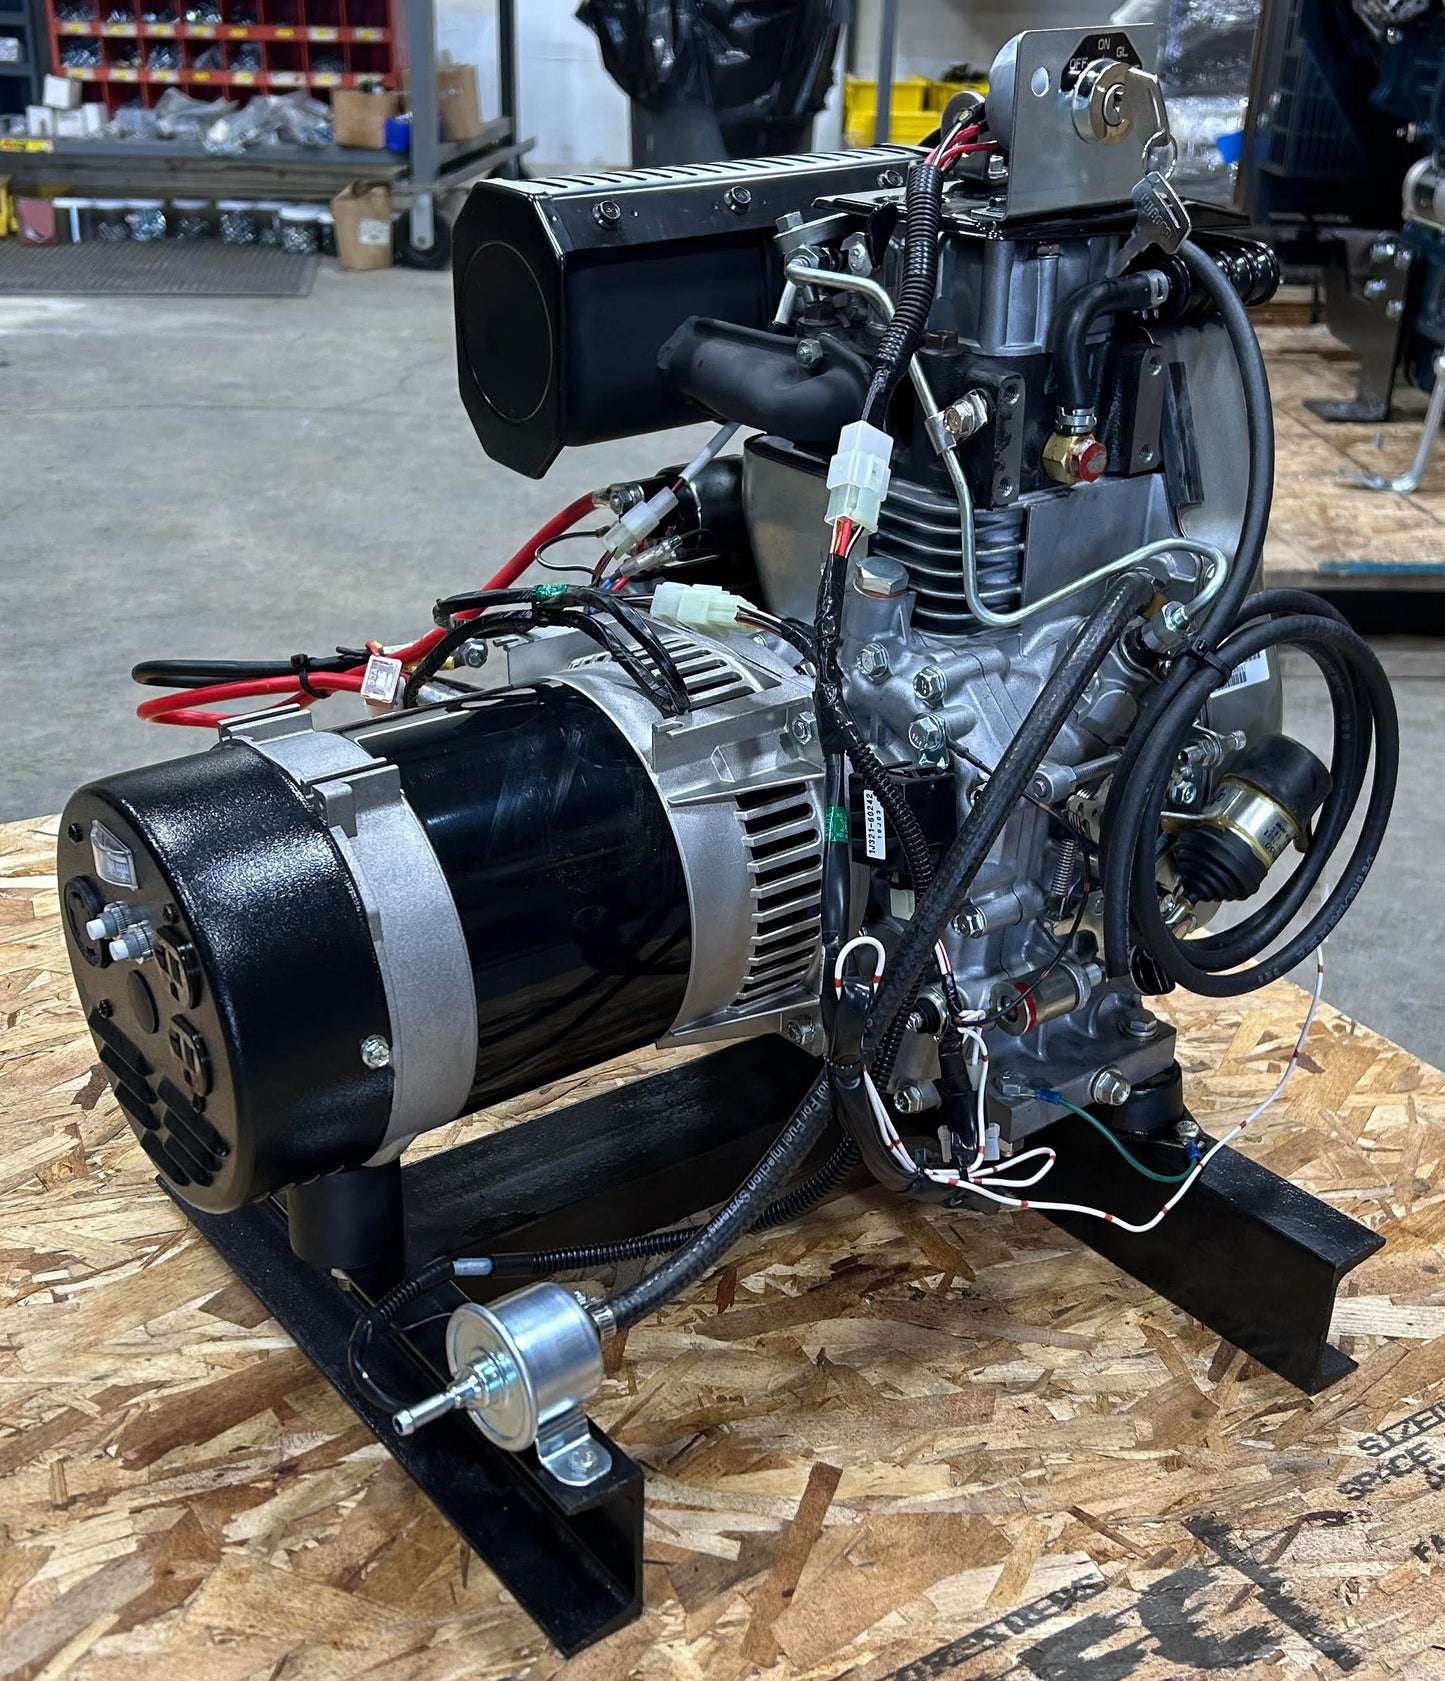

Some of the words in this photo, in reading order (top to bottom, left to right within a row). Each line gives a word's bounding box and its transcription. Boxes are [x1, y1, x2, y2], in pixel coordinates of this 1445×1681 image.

[1097, 38, 1111, 50] ON
[1116, 45, 1129, 58] GL
[1069, 57, 1089, 70] OFF
[865, 793, 876, 854] 1J321-60242
[800, 1099, 822, 1118] For
[781, 1119, 806, 1147] Fuel
[747, 1143, 789, 1191] Injection
[706, 1190, 751, 1234] Systems
